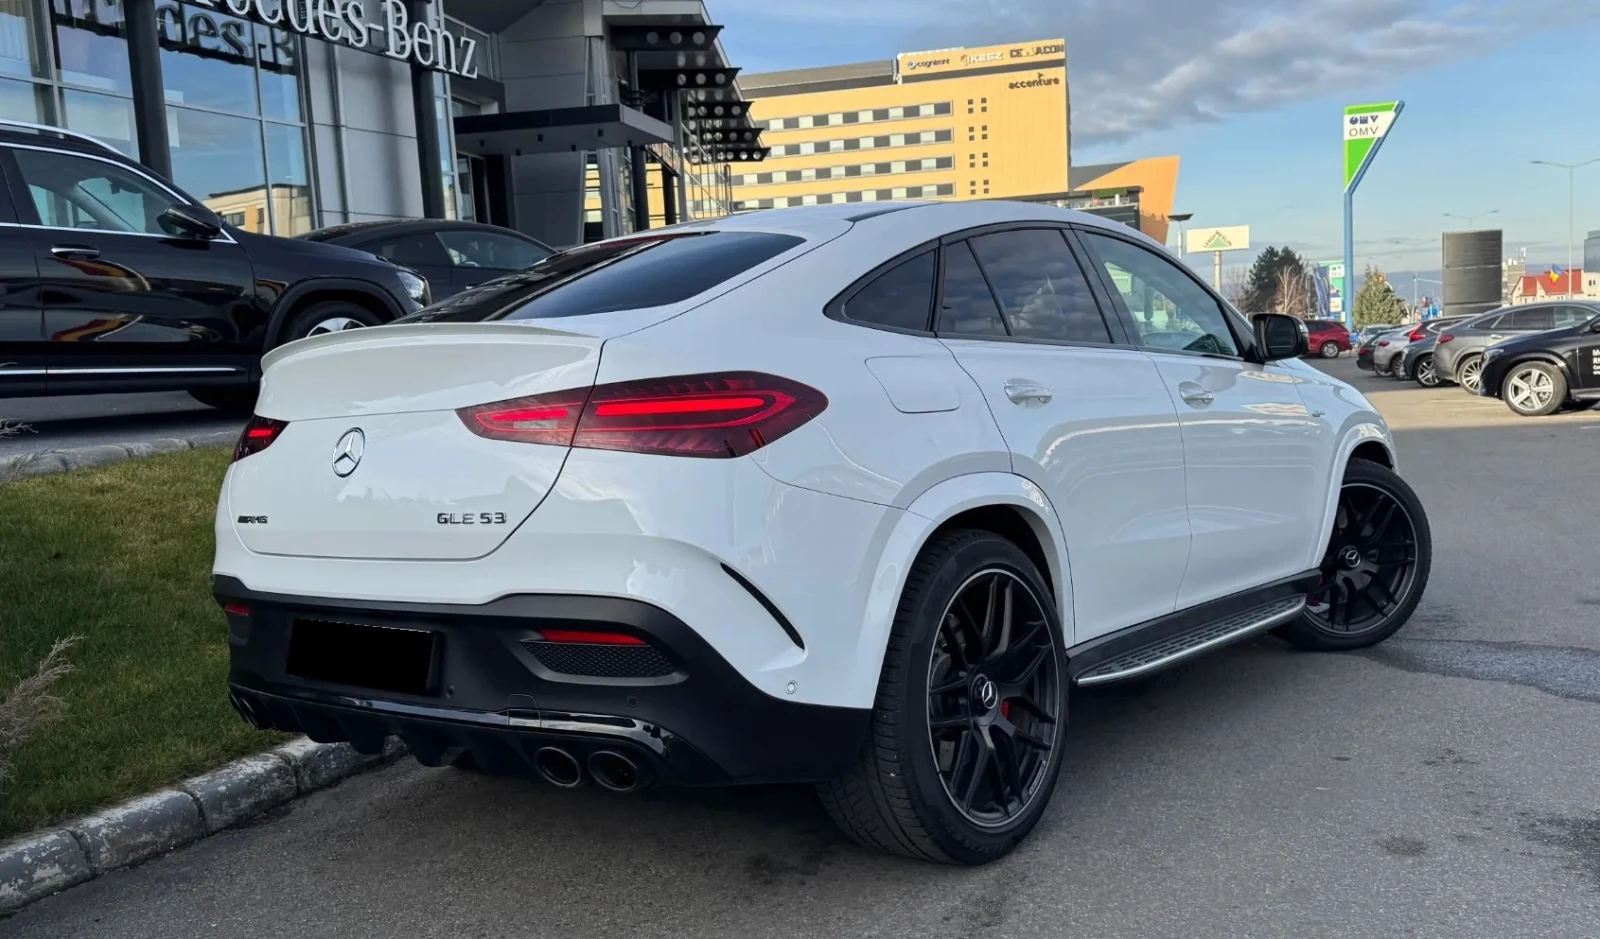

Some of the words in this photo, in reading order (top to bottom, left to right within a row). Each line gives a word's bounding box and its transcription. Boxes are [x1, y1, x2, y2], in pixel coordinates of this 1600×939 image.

[1009, 73, 1059, 89] accenture
[1349, 127, 1379, 137] OMV
[437, 512, 474, 524] GLE
[480, 512, 507, 524] 53
